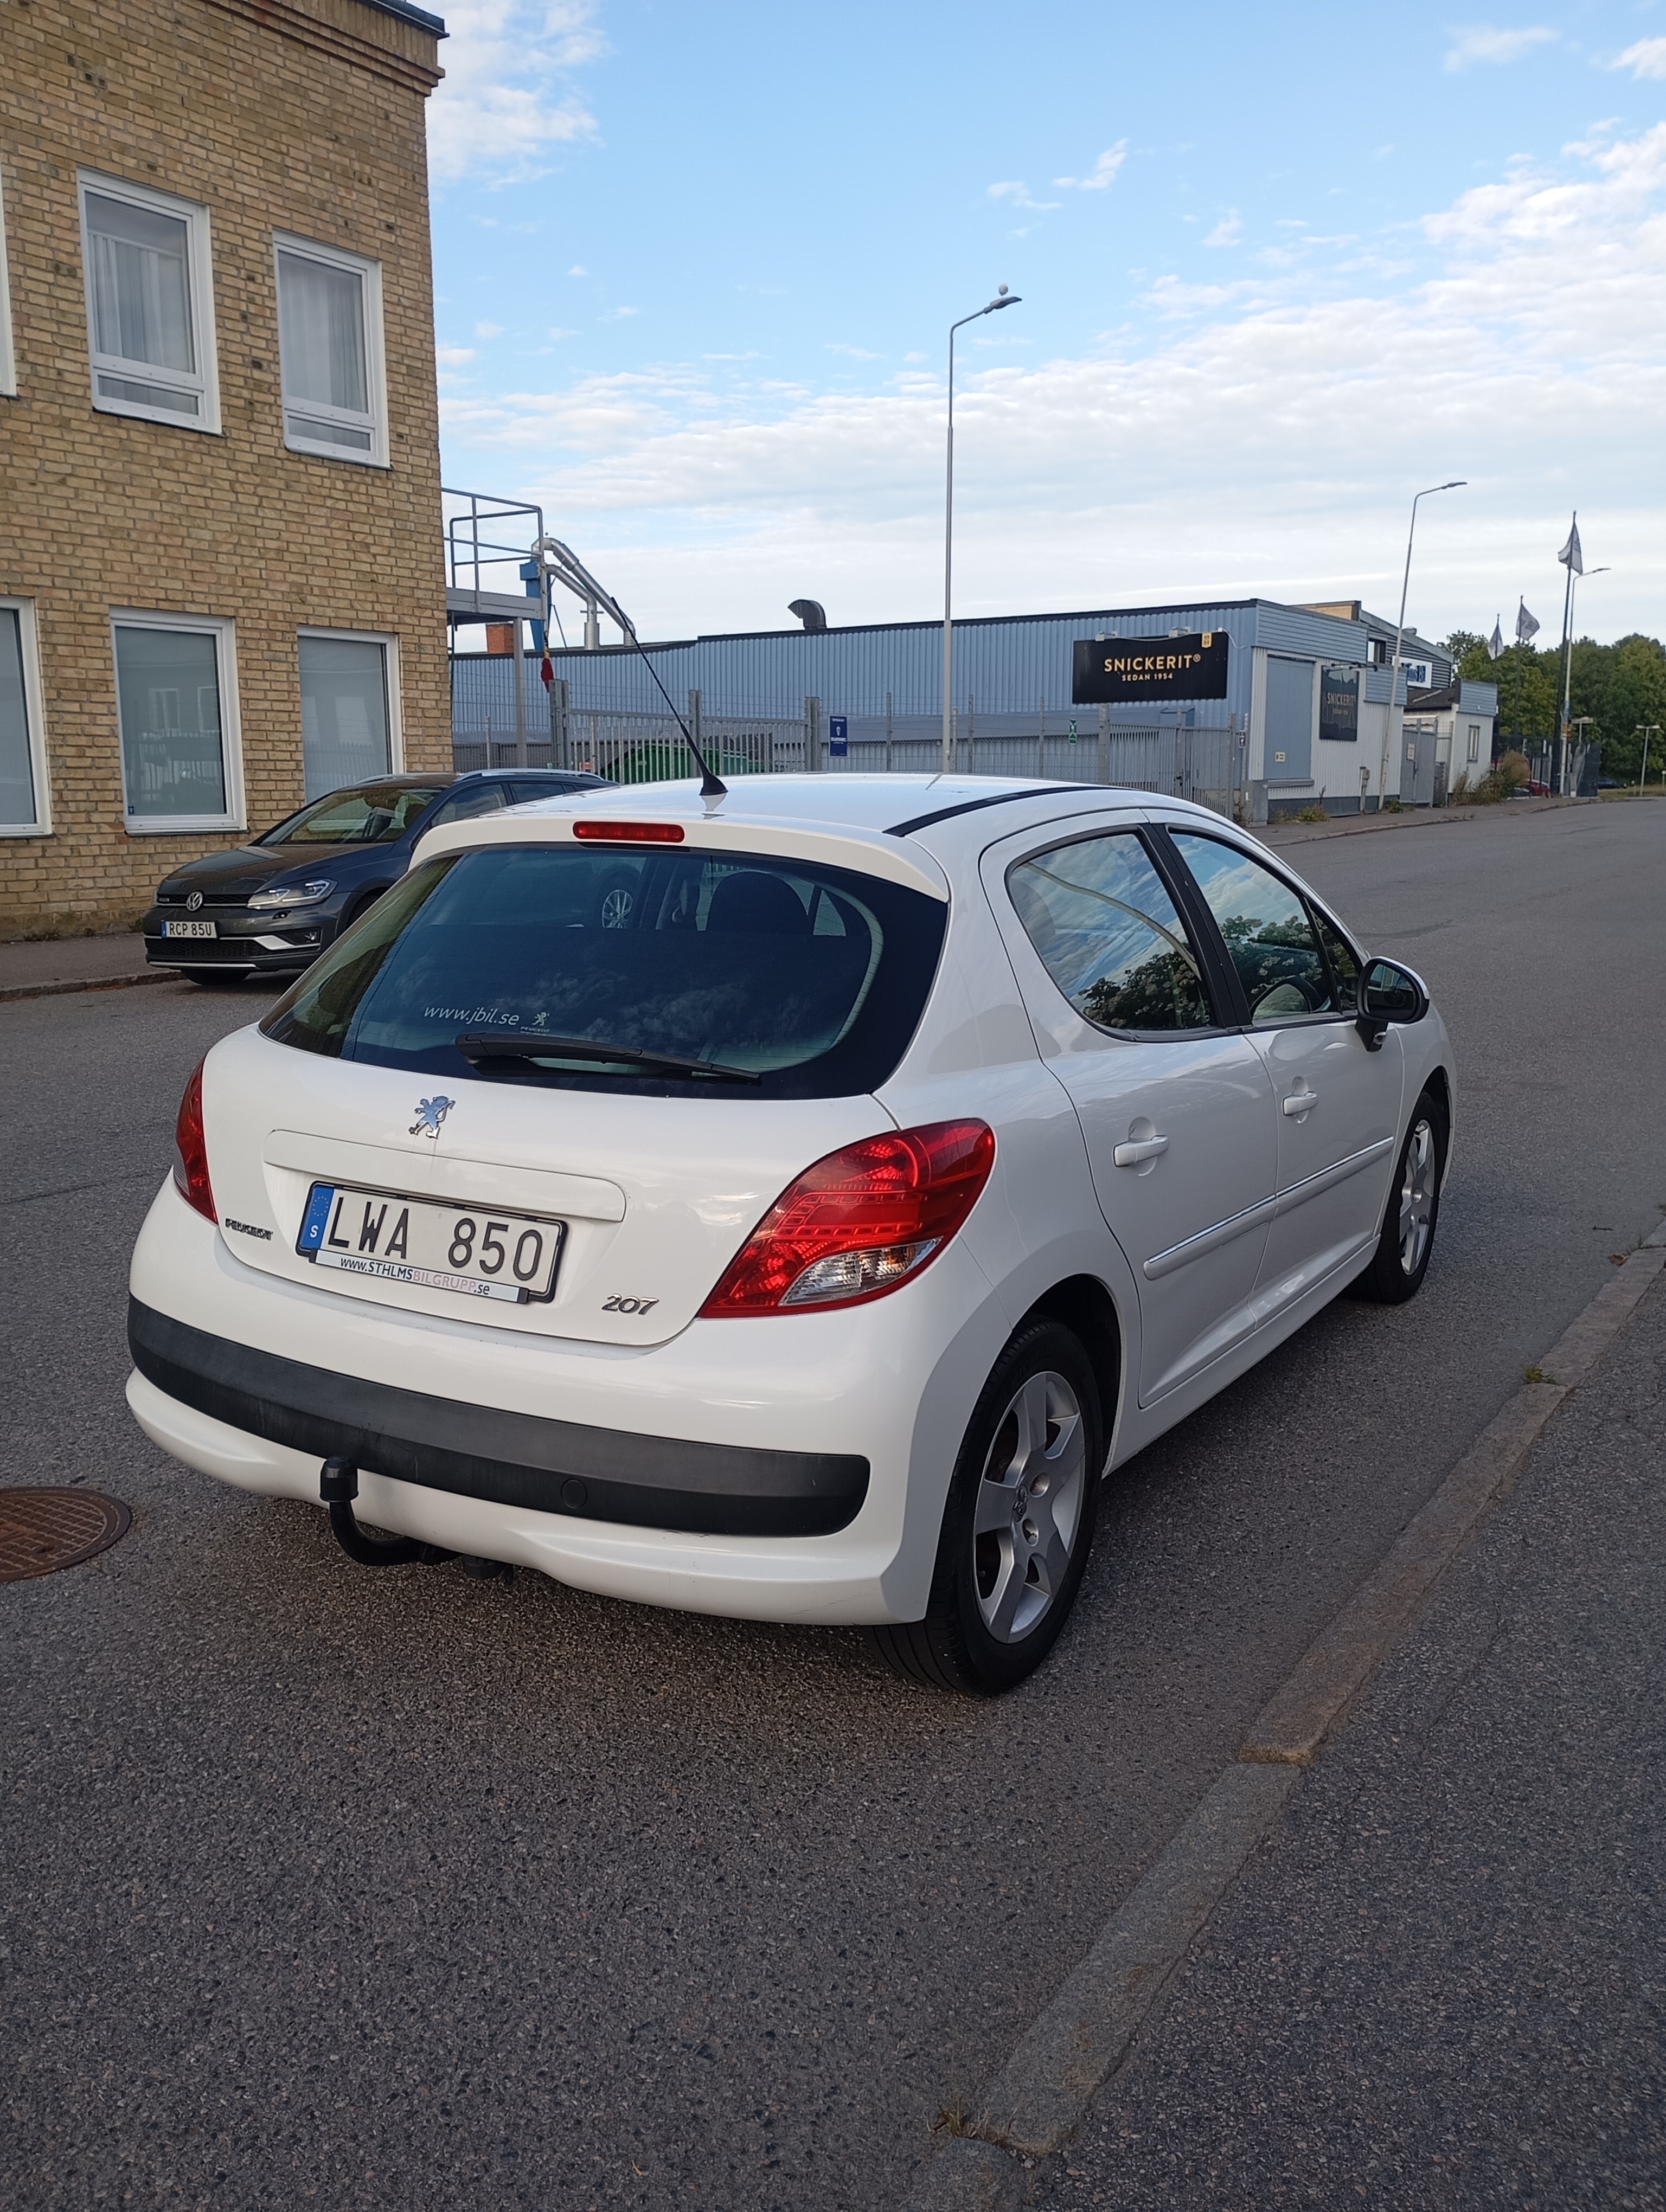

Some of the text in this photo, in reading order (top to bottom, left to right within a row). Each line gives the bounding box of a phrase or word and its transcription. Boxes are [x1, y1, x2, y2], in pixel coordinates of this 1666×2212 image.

[1154, 672, 1173, 680] 1954
[169, 923, 212, 936] RCP 85U
[424, 1006, 520, 1025] www.jbil.se
[225, 1218, 273, 1241] PEUGEOT
[309, 1224, 319, 1238] S
[328, 1196, 543, 1281] LWA 850
[340, 1257, 490, 1295] www.STHLMSBILGRUPP.se
[601, 1293, 659, 1315] 207
